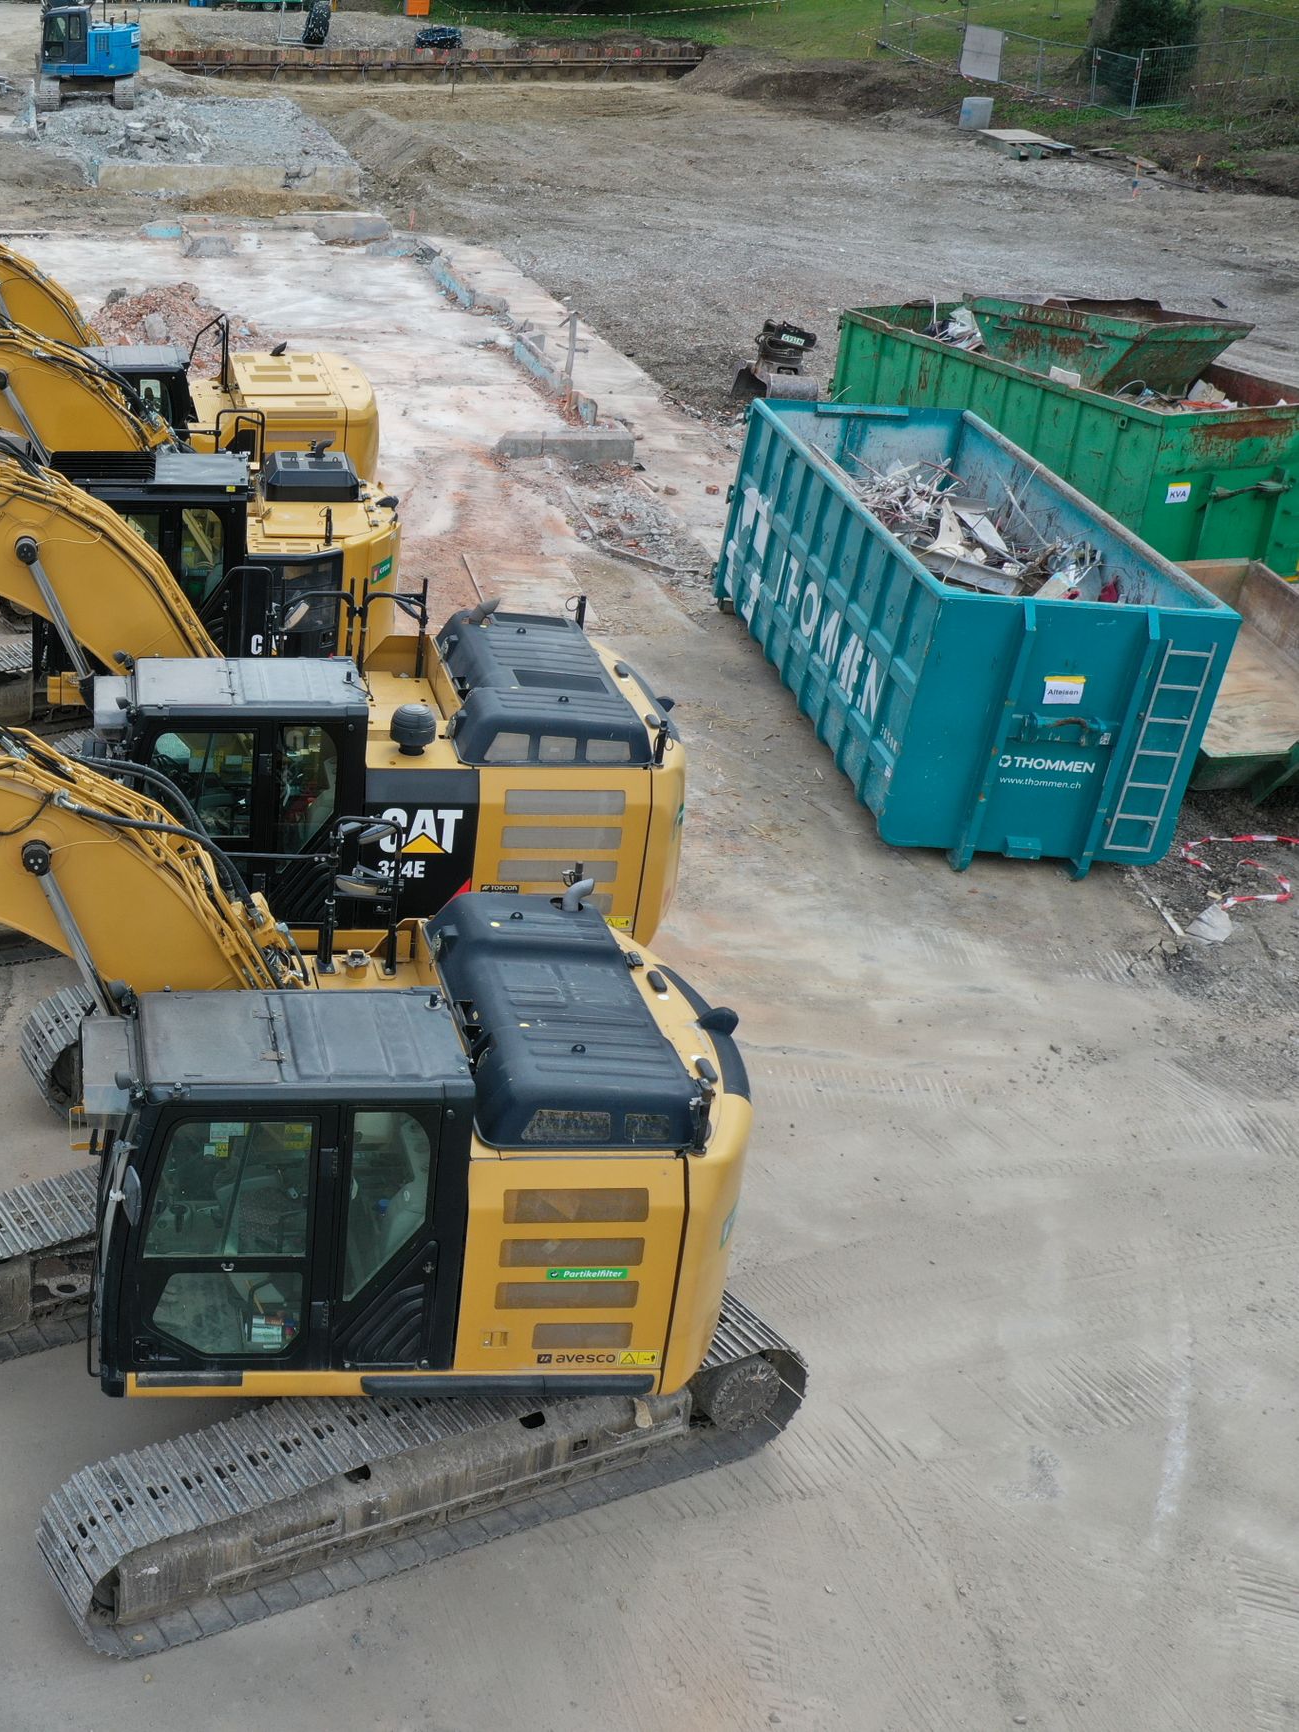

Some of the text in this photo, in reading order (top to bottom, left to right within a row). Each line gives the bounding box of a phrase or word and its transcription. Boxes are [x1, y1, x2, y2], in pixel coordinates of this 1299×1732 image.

[783, 335, 804, 344] GYSIN
[1169, 490, 1186, 498] KVA
[1047, 688, 1079, 696] Alteisen
[1014, 756, 1096, 774] THOMMEN
[1000, 776, 1082, 790] www.thommen.ch
[379, 808, 463, 854] CAT
[563, 1269, 623, 1278] Partikelfilter
[556, 1354, 616, 1364] avesco
